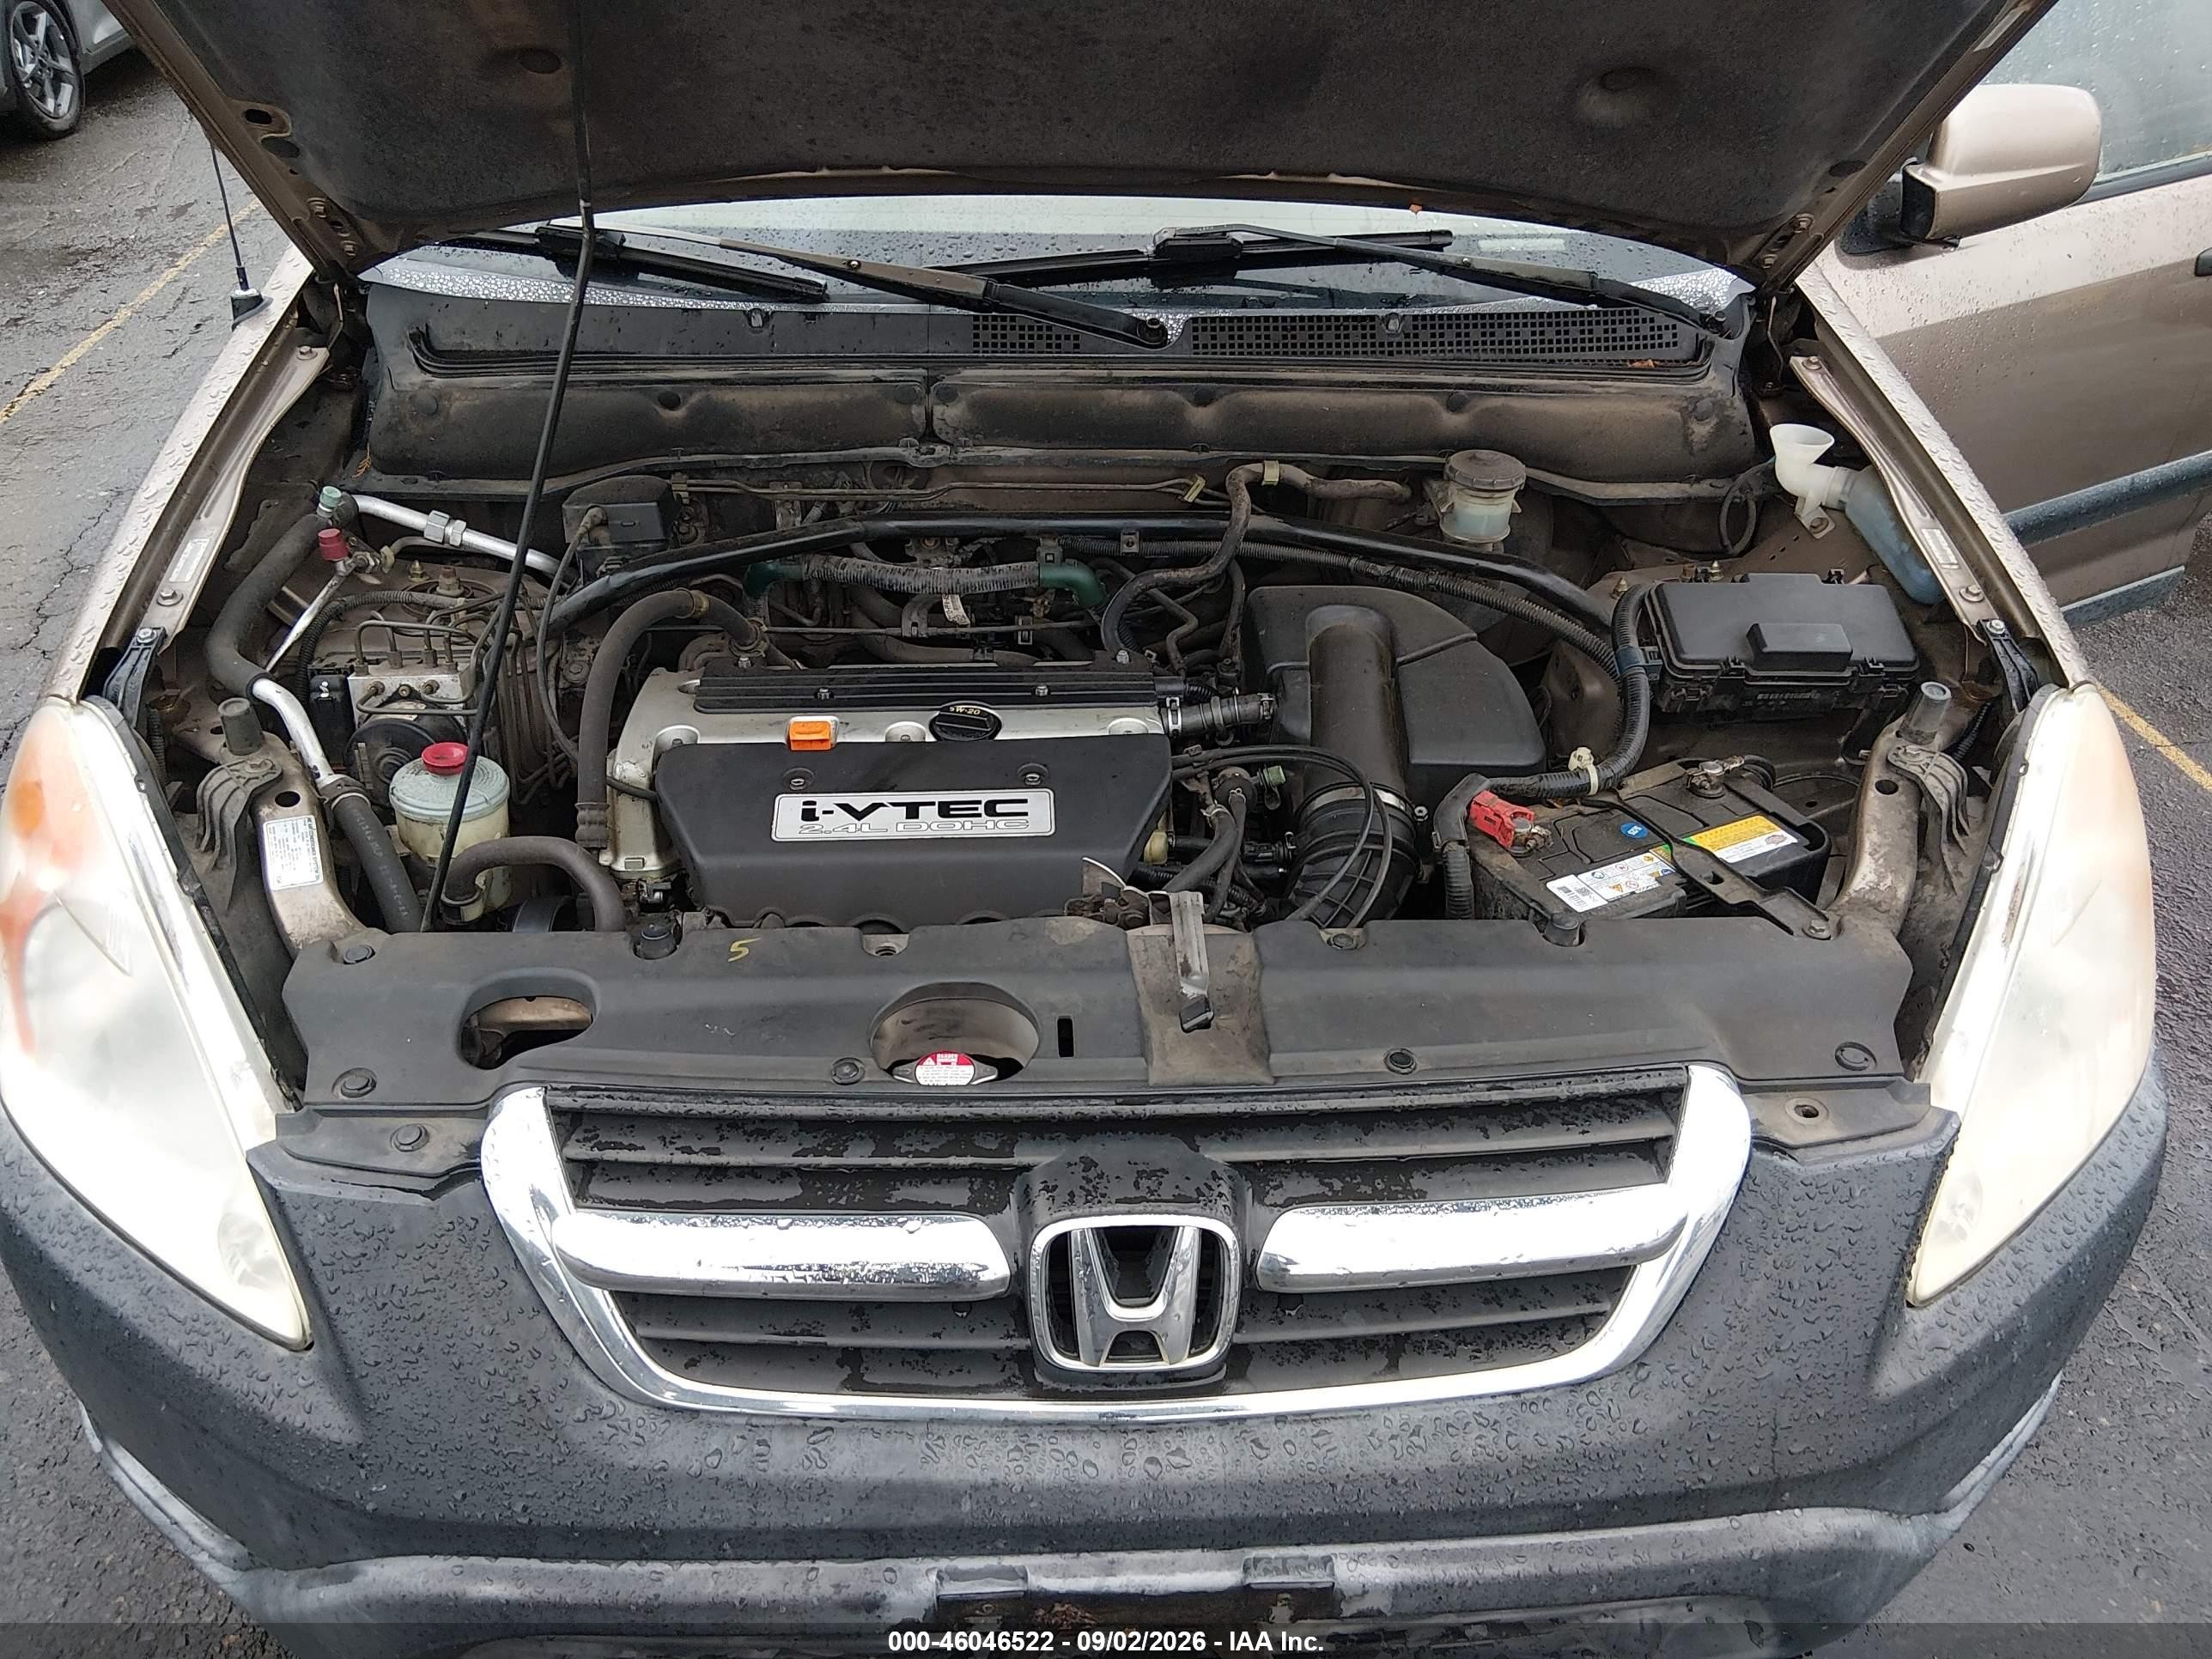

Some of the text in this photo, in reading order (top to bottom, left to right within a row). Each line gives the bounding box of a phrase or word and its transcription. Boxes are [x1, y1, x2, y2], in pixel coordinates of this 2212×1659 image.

[800, 798, 1029, 822] i-VTEC
[798, 818, 1030, 835] 2.4L DOHC
